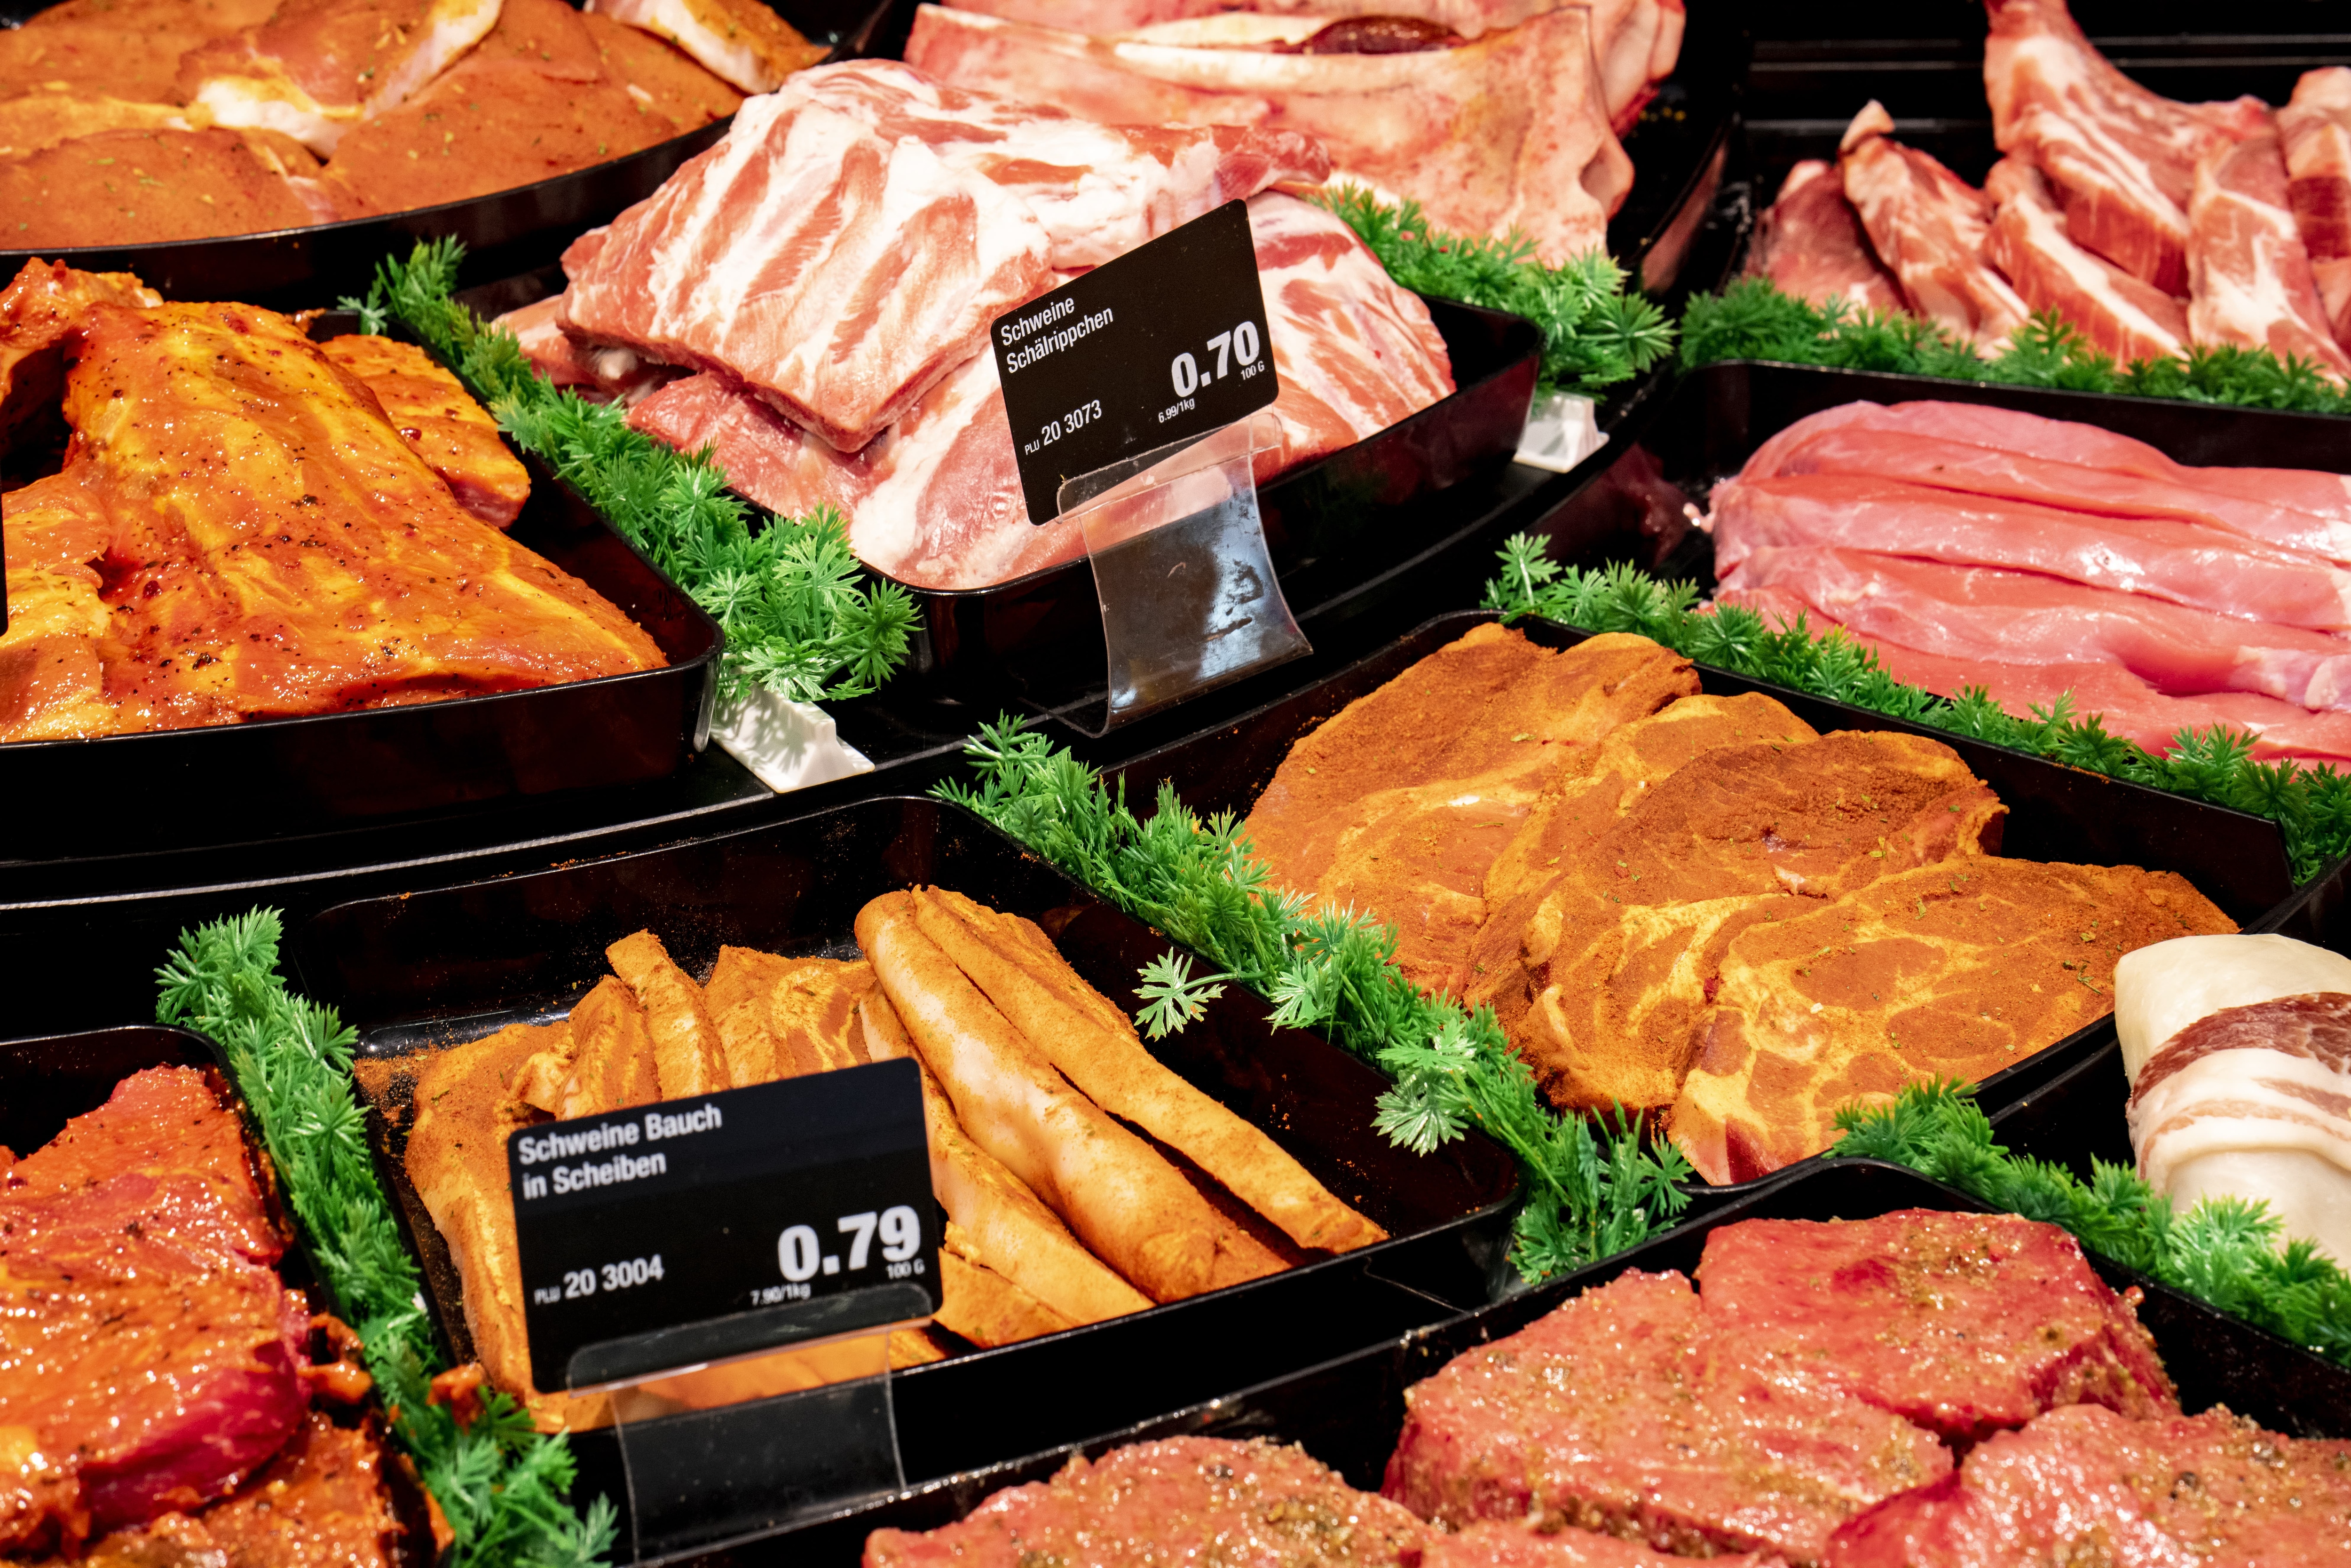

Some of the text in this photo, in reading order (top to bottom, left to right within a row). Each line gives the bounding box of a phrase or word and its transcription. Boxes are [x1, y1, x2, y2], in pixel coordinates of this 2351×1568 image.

[1000, 298, 1075, 346] Schweine
[1006, 308, 1113, 374] Schälrippchen
[1171, 321, 1260, 397] 0.70
[1240, 360, 1265, 380] 100 G
[1024, 399, 1102, 456] PLU 20 3073
[1158, 397, 1195, 423] 6.99/1kg
[518, 1103, 722, 1165] Schweine Bauch
[522, 1153, 667, 1200] in Scheiben
[777, 1205, 921, 1282] 0.79
[886, 1258, 925, 1279] 100 G
[534, 1254, 665, 1304] PLU 20 3004
